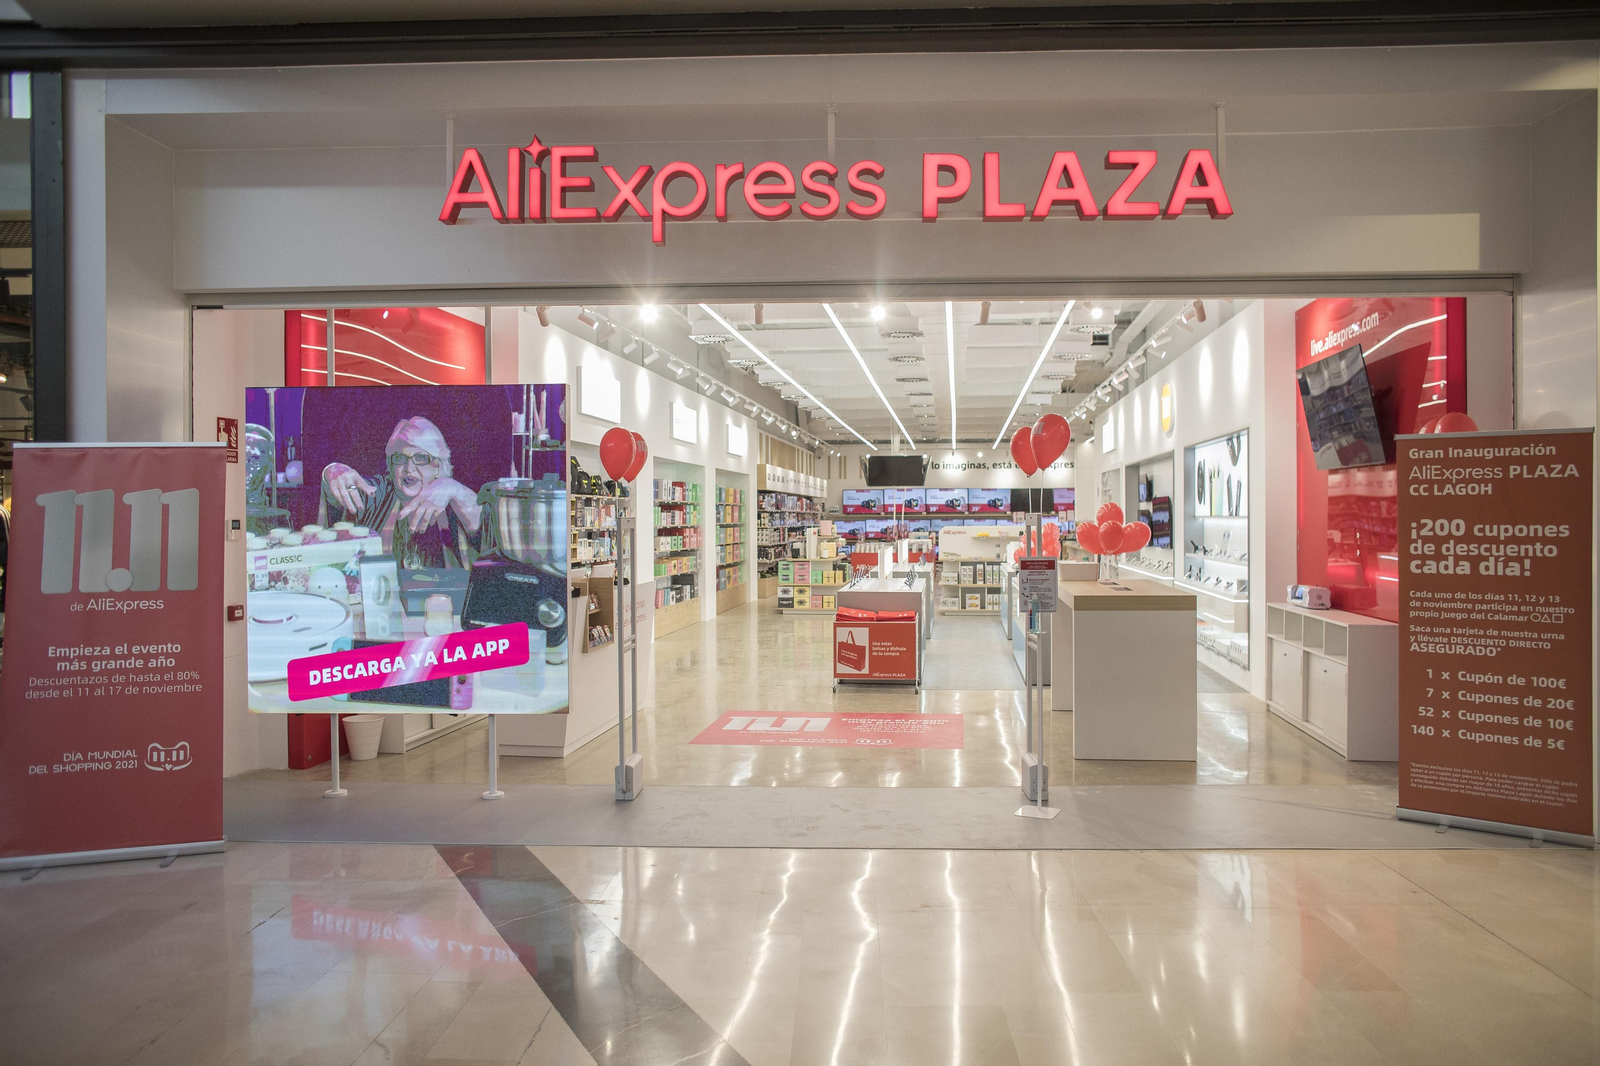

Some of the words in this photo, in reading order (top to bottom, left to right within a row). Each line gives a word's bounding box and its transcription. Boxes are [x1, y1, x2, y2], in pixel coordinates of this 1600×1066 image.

[438, 134, 888, 246] AliExpress
[922, 149, 1234, 223] PLAZA
[1311, 312, 1379, 357] live.aliexpress.com
[1409, 448, 1443, 459] Gran
[1449, 443, 1555, 459] Inauguración
[931, 461, 940, 469] lo
[943, 461, 989, 471] imaginas,
[992, 460, 1012, 469] está
[1409, 465, 1503, 483] AliExpress
[1509, 464, 1579, 478] PLAZA
[1410, 484, 1429, 496] CC
[1434, 483, 1492, 495] LAGOH
[1411, 519, 1466, 539] ¡200
[1473, 524, 1569, 540] cupones
[36, 488, 199, 594] 11.11
[1410, 540, 1435, 555] de
[1441, 540, 1557, 557] descuento
[270, 555, 302, 565] CLASSIC
[1410, 556, 1470, 574] cada
[1479, 556, 1531, 576] día!
[1410, 590, 1432, 599] Cada
[1454, 591, 1466, 599] de
[1469, 592, 1482, 600] los
[1485, 592, 1504, 600] días
[1508, 594, 1521, 602] 11,
[70, 603, 83, 612] de
[87, 598, 164, 613] AliExpress
[1423, 600, 1472, 609] noviembre
[1475, 602, 1518, 613] participa
[1536, 606, 1575, 614] nuestro
[1410, 610, 1439, 619] propio
[1440, 611, 1467, 620] Juego
[1488, 613, 1528, 622] Calamar
[1453, 626, 1484, 637] tarjeta
[1486, 628, 1498, 636] de
[1501, 630, 1538, 638] nuestra
[1418, 635, 1448, 643] llévate
[1451, 637, 1506, 646] DESCUENTO
[1509, 640, 1550, 649] DIRECTO
[48, 644, 110, 659] Empieza
[115, 643, 128, 655] el
[132, 643, 181, 654] evento
[57, 658, 87, 671] más
[92, 657, 144, 672] grande
[148, 656, 176, 667] año
[309, 657, 406, 686] DESCARGA
[410, 652, 437, 668] YA
[443, 646, 467, 663] LA
[472, 639, 510, 659] APP
[29, 675, 108, 686] Descuentazos
[111, 673, 126, 683] de
[130, 672, 160, 682] hasta
[164, 671, 174, 680] el
[177, 671, 200, 680] 80%
[1426, 669, 1433, 678] 1
[1441, 671, 1450, 679] x
[1458, 671, 1502, 684] Cupón
[1507, 674, 1526, 685] de
[1531, 677, 1566, 689] 100€
[26, 688, 60, 699] desde
[63, 687, 73, 697] el
[78, 688, 89, 697] 11
[94, 686, 105, 696] al
[110, 686, 121, 695] 17
[125, 685, 139, 695] de
[143, 683, 202, 694] noviembre
[1426, 688, 1434, 698] 7
[1441, 691, 1450, 699] x
[1458, 690, 1519, 705] Cupones
[1523, 696, 1542, 707] de
[1547, 698, 1574, 710] 20€
[1418, 707, 1434, 717] 52
[1441, 710, 1450, 718] x
[1458, 710, 1519, 724] Cupones
[1523, 716, 1542, 727] de
[1548, 718, 1574, 730] 10€
[1411, 725, 1434, 736] 140
[1441, 729, 1450, 737] x
[1458, 729, 1519, 743] Cupones
[1523, 736, 1542, 747] de
[1547, 738, 1565, 750] 5€
[64, 751, 83, 762] DÍA
[88, 750, 137, 760] MUNDIAL
[29, 765, 48, 775] DEL
[53, 762, 112, 773] SHOPPING
[115, 760, 138, 770] 2021
